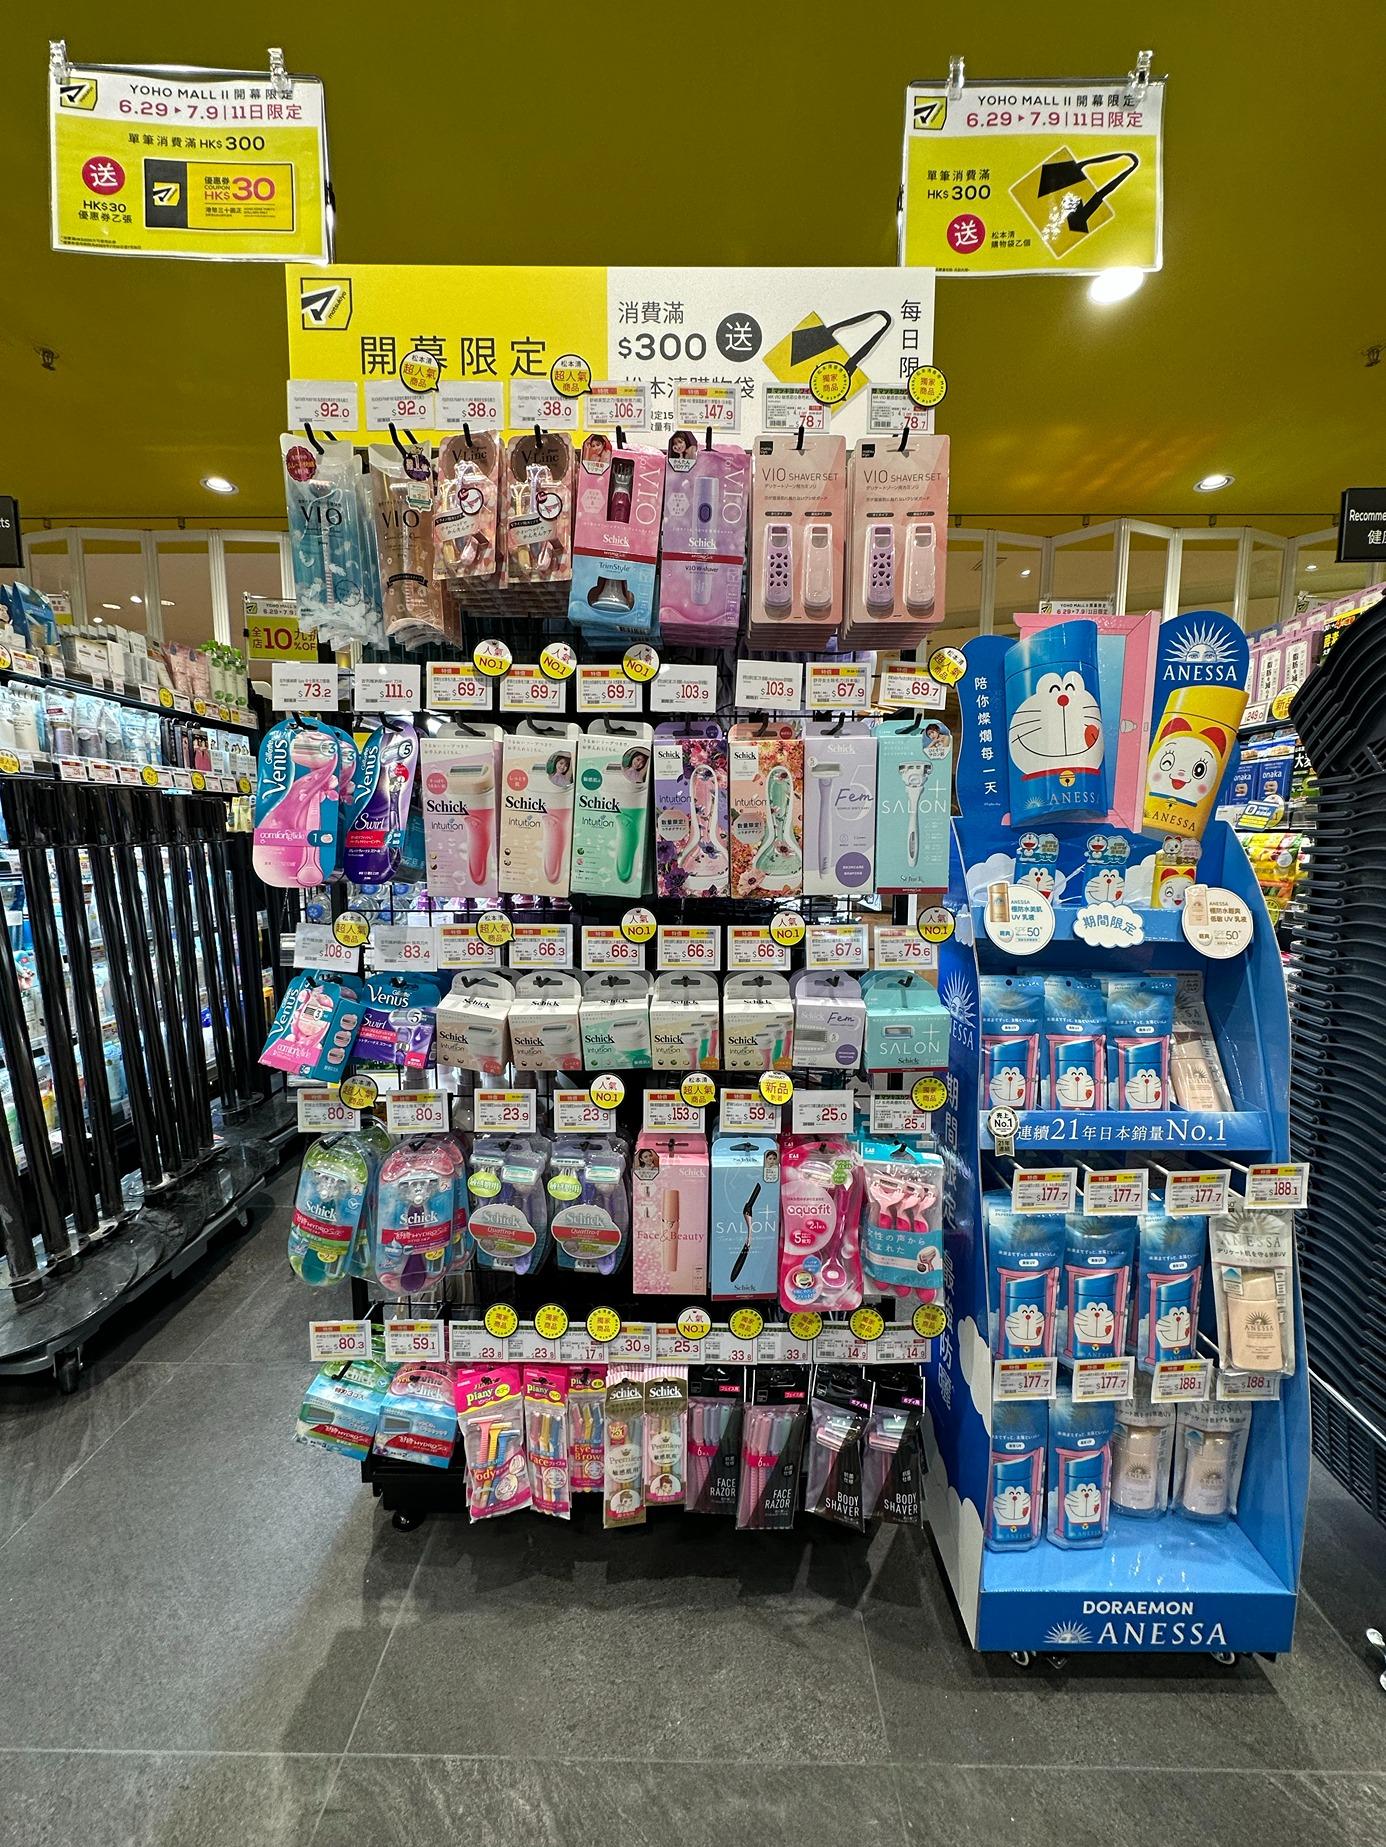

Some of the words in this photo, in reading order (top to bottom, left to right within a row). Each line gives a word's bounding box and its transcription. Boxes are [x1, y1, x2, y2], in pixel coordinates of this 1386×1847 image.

[130, 85, 172, 99] YOHO
[178, 88, 217, 100] MALL
[221, 90, 229, 100] II
[234, 88, 294, 101] 開幕限定
[978, 95, 1017, 106] YOHO
[1022, 96, 1060, 106] MALL
[1064, 96, 1071, 106] II
[1076, 95, 1136, 107] 開幕限定
[119, 100, 168, 117] 6.29
[187, 105, 218, 119] 7.9
[966, 112, 1012, 128] 6.29
[1030, 112, 1060, 126] 7.9
[128, 132, 197, 149] 單筆消費滿
[225, 136, 266, 151] 300
[90, 162, 118, 188] 送
[927, 169, 990, 181] 單筆消費滿
[232, 177, 275, 202] 30
[952, 185, 991, 200] 300
[78, 211, 133, 224] 優惠券乙張
[954, 220, 979, 247] 送
[618, 301, 684, 325] 消費滿
[724, 321, 753, 352] 送
[618, 333, 707, 361] $300
[314, 402, 350, 419] $92.0
[391, 400, 427, 416] $92.0
[461, 402, 497, 418] $38.0
[537, 400, 572, 417] $38.0
[609, 402, 643, 419] $106.7
[699, 404, 734, 420] $147.9
[762, 468, 786, 482] VIO
[789, 473, 821, 481] SHAVER
[823, 473, 838, 481] SET
[864, 470, 888, 483] VIO
[891, 474, 924, 482] SHAVER
[300, 506, 343, 526] VIO
[382, 510, 420, 528] VIO
[603, 534, 630, 548] Schick
[689, 536, 717, 550] Schick
[264, 628, 293, 650] 10
[479, 657, 504, 669] NO.1
[543, 656, 567, 674] NO.1
[626, 661, 650, 677] NO.1
[1163, 664, 1237, 682] ANESSA
[298, 683, 331, 698] $73.2
[380, 684, 413, 698] $111.0
[452, 682, 485, 697] $69.7
[525, 685, 557, 699] $69.7
[601, 685, 634, 699] $69.7
[676, 685, 709, 699] $103.9
[761, 681, 794, 697] $103.9
[832, 683, 865, 697] $67.9
[906, 682, 939, 697] $69.7
[974, 677, 997, 795] 陪你燦爛每一天
[658, 751, 681, 759] Schick
[734, 752, 756, 760] Schick
[827, 744, 856, 755] Schick
[261, 738, 288, 799] Venus
[355, 746, 379, 803] Venus
[505, 796, 547, 813] Schick
[579, 795, 622, 813] Schick
[659, 795, 691, 804] Intuition
[735, 797, 768, 807] Intuition
[835, 788, 874, 807] Fem
[427, 799, 469, 815] Schick
[881, 799, 947, 814] SALON
[431, 819, 464, 831] Intuition
[508, 815, 541, 828] Intuition
[582, 815, 614, 828] Intuition
[1151, 810, 1197, 832] ANESSA
[627, 926, 651, 936] NO.1
[924, 926, 948, 936] NO.1
[1082, 914, 1137, 937] 期間限定
[776, 929, 800, 939] NO.1
[319, 943, 351, 960] $108.0
[399, 945, 430, 959] $83.4
[462, 942, 494, 956] $66.3
[533, 943, 565, 957] $66.3
[606, 944, 638, 958] $66.3
[682, 944, 714, 958] $66.3
[752, 944, 784, 958] $66.3
[830, 943, 862, 957] $67.9
[898, 943, 930, 957] $75.6
[367, 983, 410, 1008] Venus
[462, 998, 490, 1009] Schick
[268, 988, 300, 1039] Venus
[827, 1011, 855, 1023] Fem
[439, 1030, 468, 1044] Schick
[514, 1037, 543, 1046] Schick
[585, 1035, 615, 1044] Schick
[654, 1035, 684, 1044] Schick
[728, 1036, 758, 1046] Schick
[880, 1041, 940, 1055] SALON
[765, 1081, 789, 1094] 新品
[596, 1092, 618, 1102] NO.1
[323, 1107, 354, 1121] $80.3
[411, 1107, 442, 1121] $80.3
[498, 1107, 529, 1121] $23.9
[578, 1108, 609, 1121] $23.9
[667, 1107, 699, 1121] $153.0
[744, 1107, 775, 1120] $59.4
[816, 1107, 848, 1121] $25.0
[994, 1119, 1012, 1129] No.1
[678, 1167, 706, 1178] Schick
[1037, 1187, 1068, 1202] $177.7
[1108, 1189, 1140, 1203] $177.7
[1190, 1190, 1222, 1203] $177.7
[305, 1201, 338, 1220] Schick
[787, 1204, 831, 1217] aquafit
[399, 1212, 438, 1224] Schick
[637, 1231, 659, 1240] Face
[670, 1231, 704, 1242] Beauty
[683, 1325, 704, 1333] NO.1
[334, 1338, 365, 1350] $80.3
[408, 1338, 436, 1350] $59.1
[620, 1340, 650, 1352] $30.9
[1018, 1376, 1049, 1389] $177.7
[1096, 1376, 1126, 1389] $177.7
[610, 1387, 644, 1400] Schick
[650, 1387, 683, 1399] Schick
[717, 1478, 736, 1488] FACE
[710, 1486, 736, 1497] RAZOR
[773, 1489, 792, 1499] FACE
[895, 1492, 917, 1505] BODY
[765, 1499, 791, 1509] RAZOR
[837, 1492, 859, 1506] BODY
[825, 1498, 860, 1517] SHAVER
[883, 1499, 918, 1515] SHAVER
[1083, 1601, 1194, 1615] DORAEMON
[1098, 1622, 1228, 1645] ANESSA
